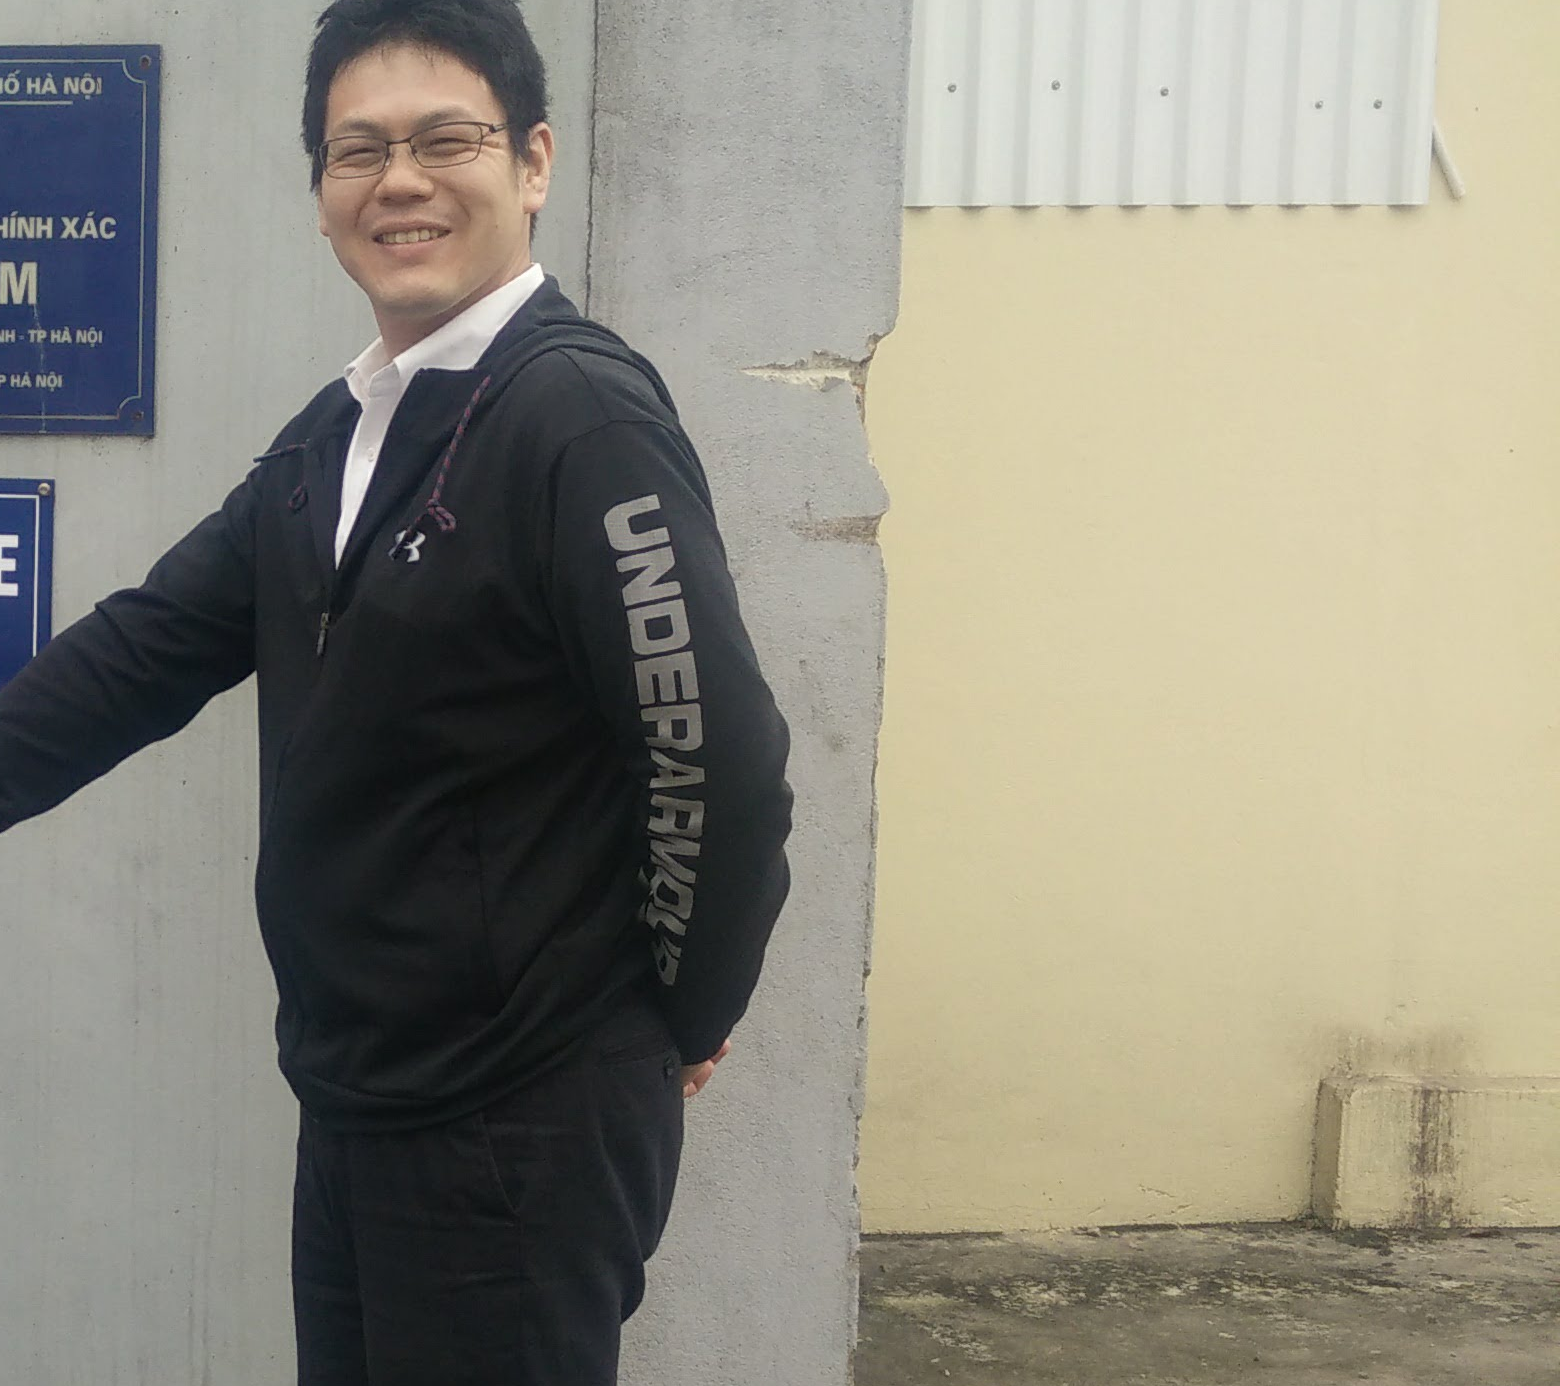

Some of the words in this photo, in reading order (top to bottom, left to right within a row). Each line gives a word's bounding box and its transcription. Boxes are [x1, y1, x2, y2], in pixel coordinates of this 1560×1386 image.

[26, 73, 58, 95] HÀ
[63, 73, 103, 101] NỘI
[60, 211, 117, 240] XÁC
[28, 330, 47, 344] TP
[51, 327, 72, 344] HÀ
[76, 327, 103, 348] NỘI
[35, 371, 63, 392] NỘI
